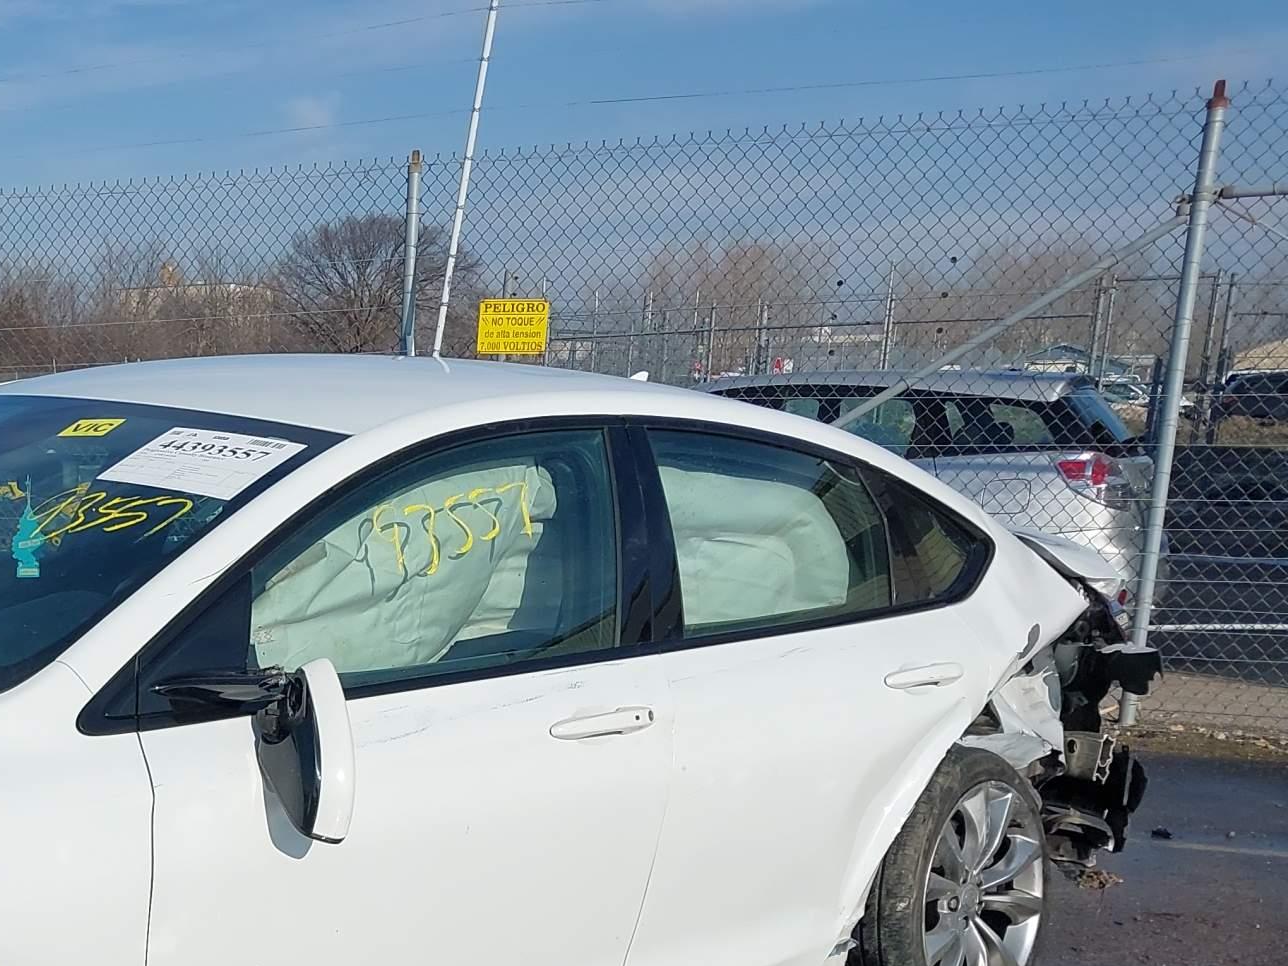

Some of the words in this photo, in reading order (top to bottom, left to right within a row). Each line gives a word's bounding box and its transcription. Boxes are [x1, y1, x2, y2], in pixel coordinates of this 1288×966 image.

[484, 302, 546, 313] PELIGRO
[491, 316, 504, 327] NO
[505, 316, 535, 327] TOQUE
[484, 329, 495, 338] de
[496, 329, 510, 338] alta
[503, 341, 543, 351] VOLTIOS
[71, 422, 114, 433] VIC
[158, 438, 272, 461] 44393557
[373, 482, 533, 576] 93557
